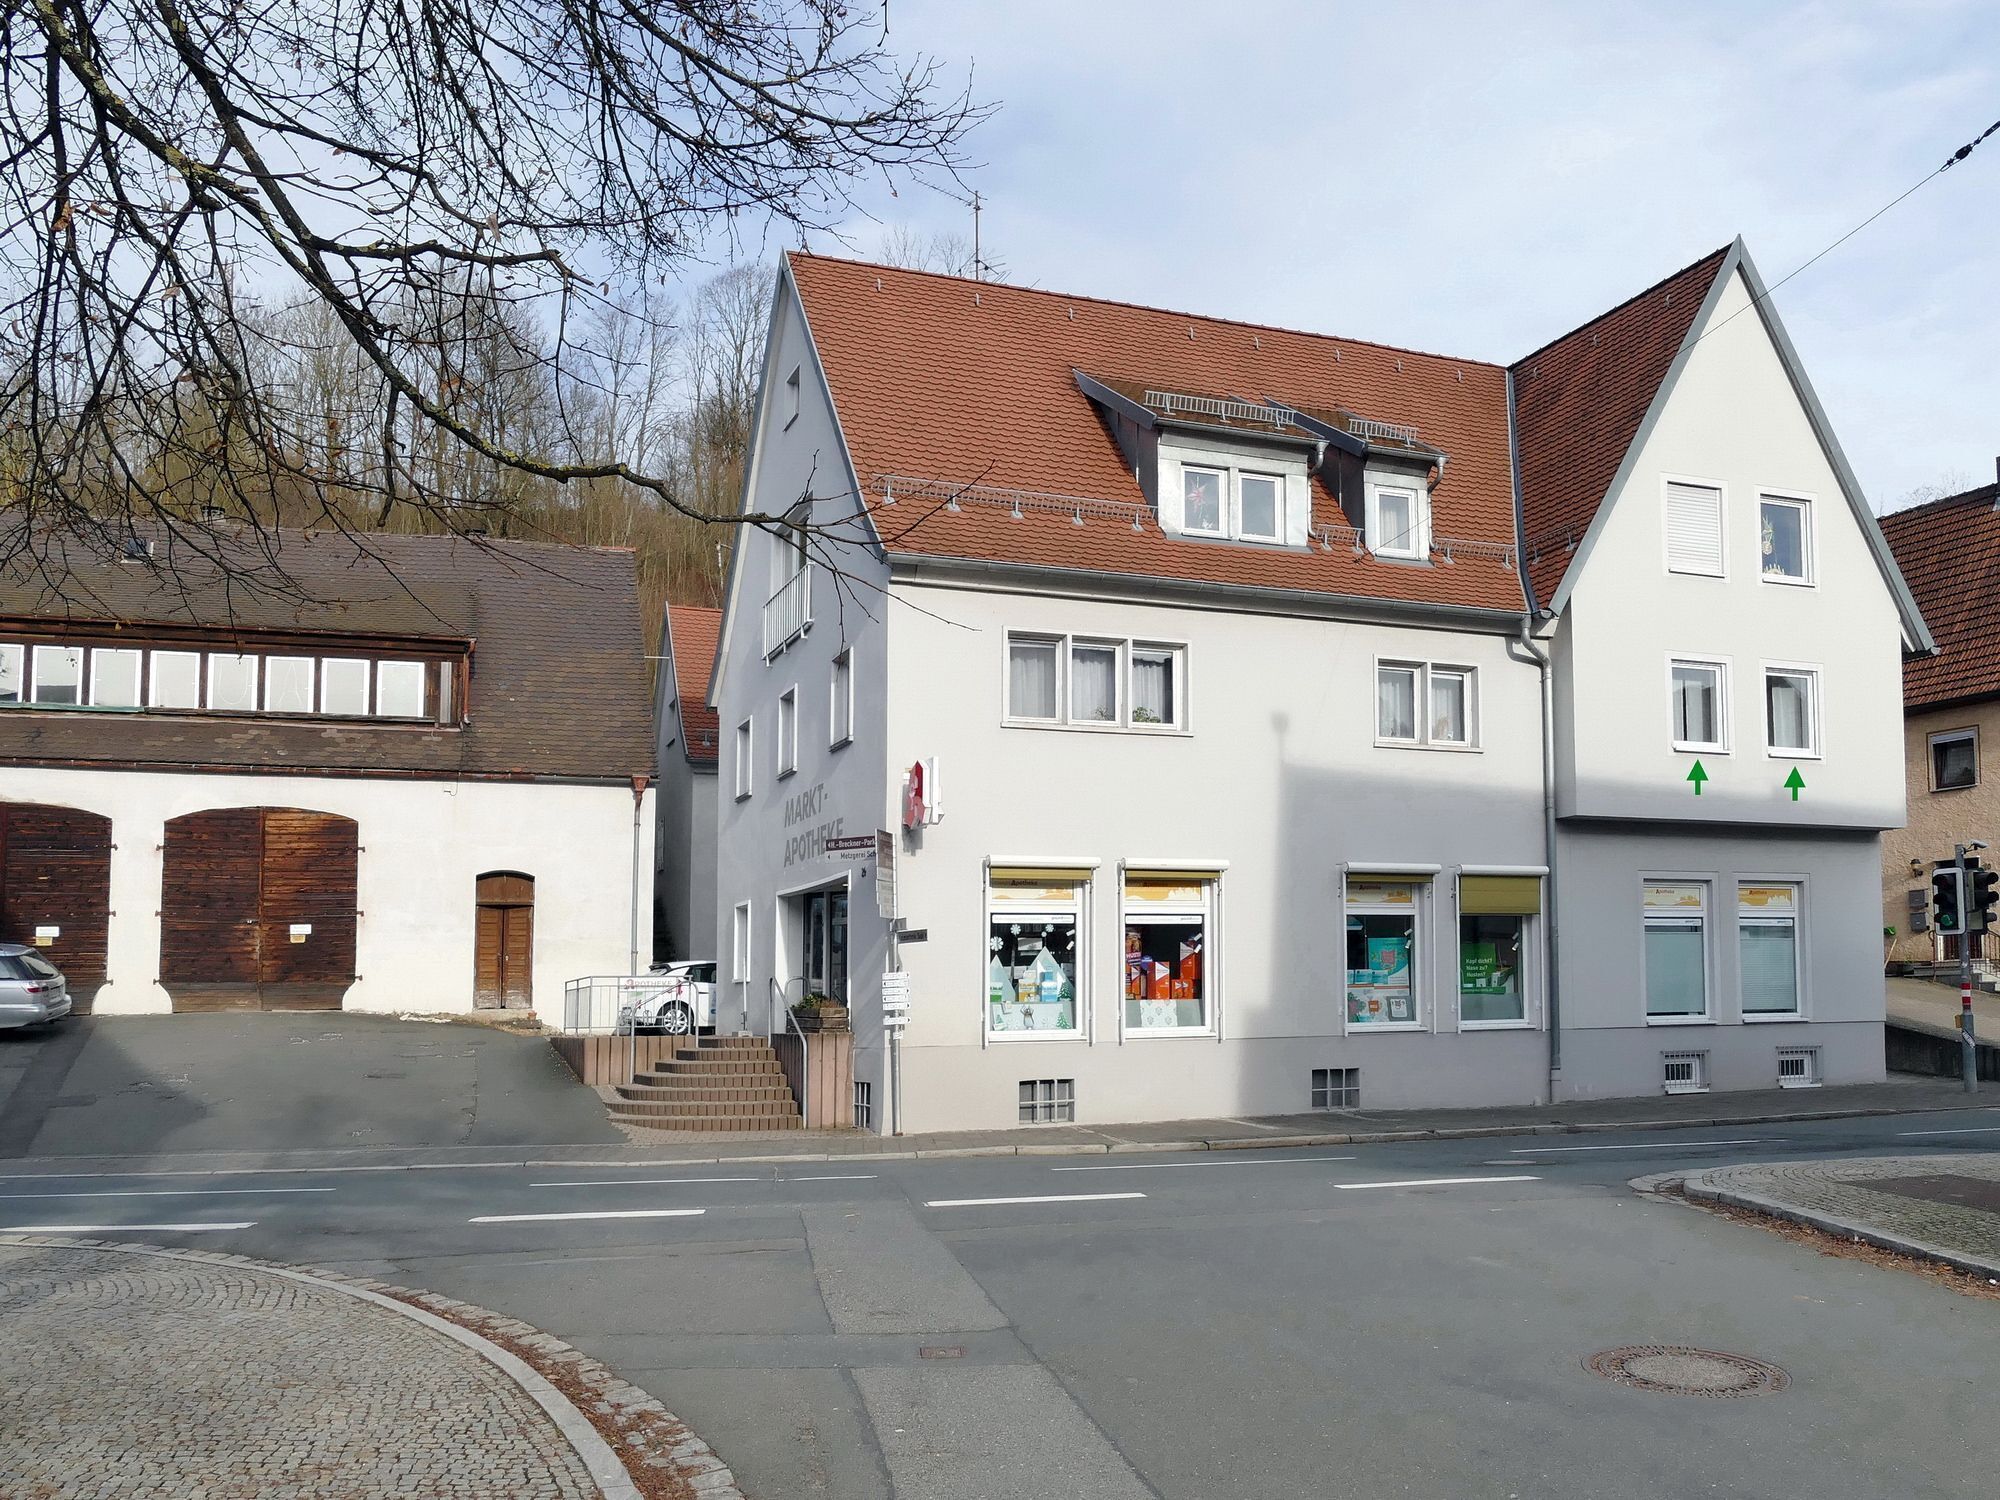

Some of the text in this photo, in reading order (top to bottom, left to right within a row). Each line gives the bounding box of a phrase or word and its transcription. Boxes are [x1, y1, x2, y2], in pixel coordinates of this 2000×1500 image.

[784, 783, 828, 828] MARKT-
[784, 817, 844, 867] APOTHEKE
[841, 851, 866, 860] Metzgerei
